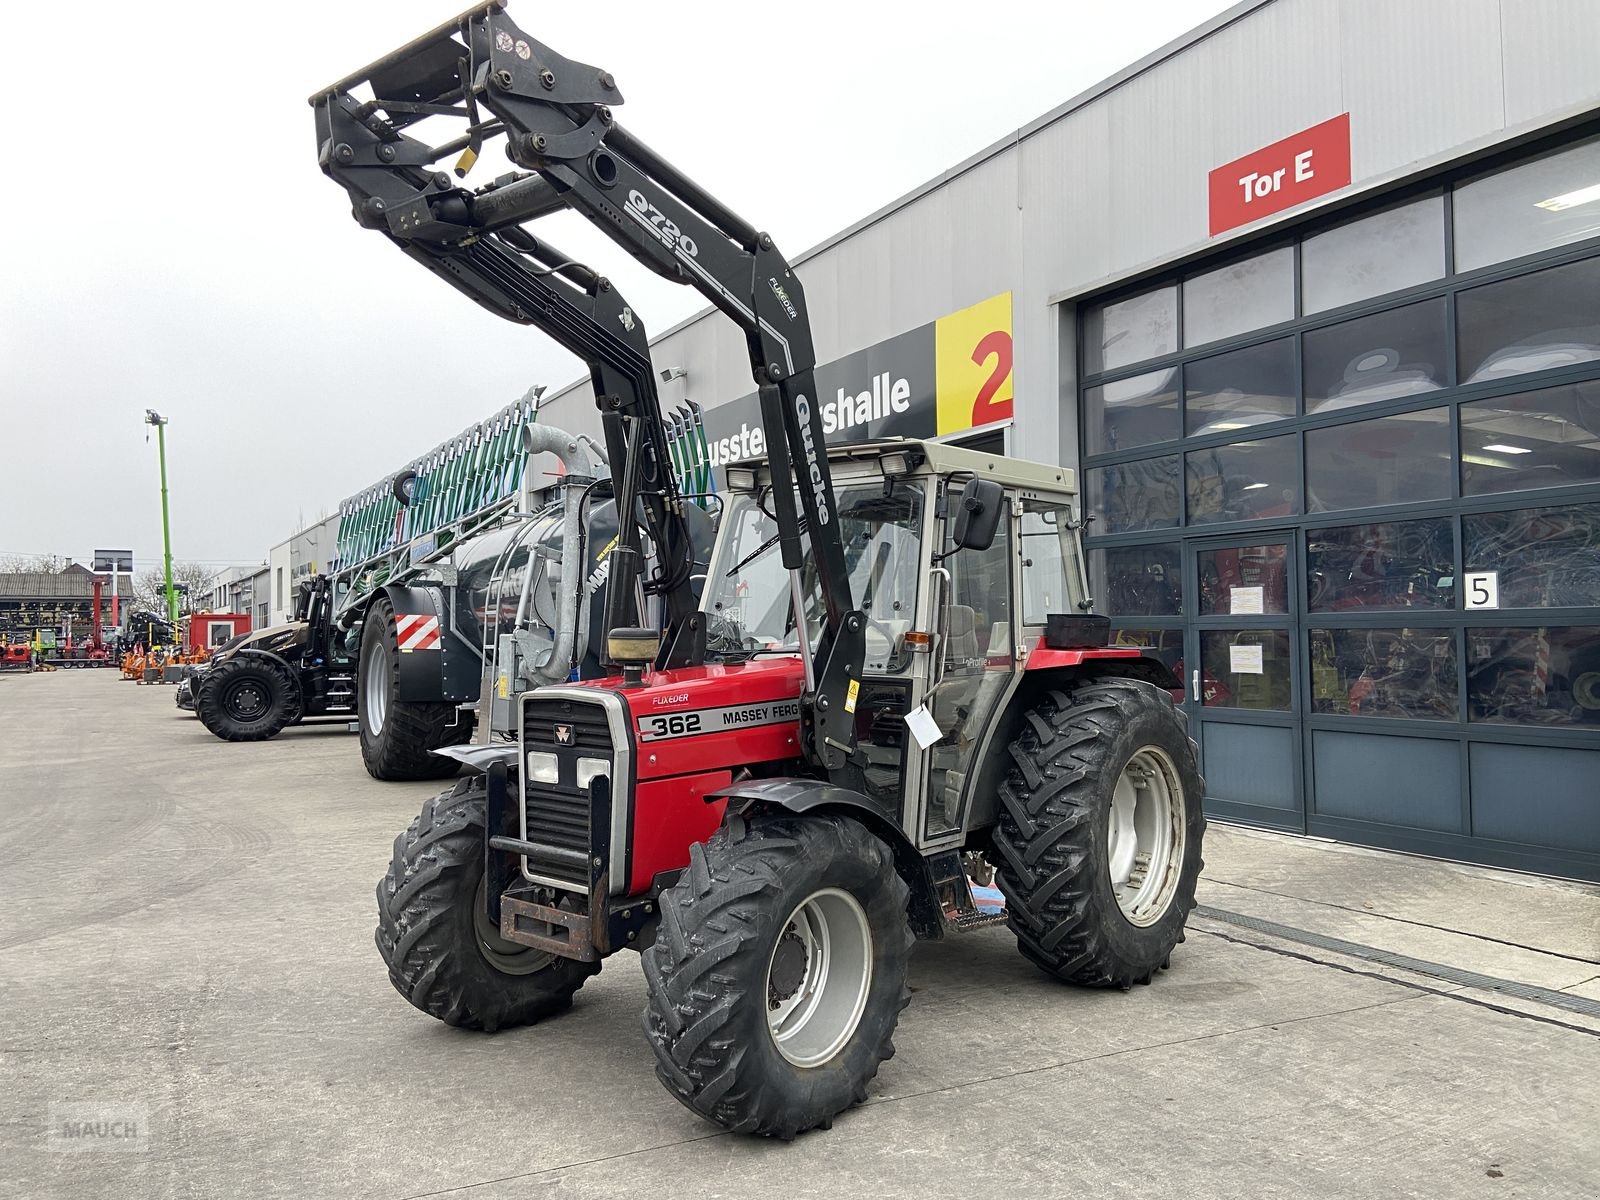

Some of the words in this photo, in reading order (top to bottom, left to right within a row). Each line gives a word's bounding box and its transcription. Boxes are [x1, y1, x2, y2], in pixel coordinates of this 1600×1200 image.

[1238, 167, 1286, 203] Tor
[1295, 149, 1314, 183] E
[628, 189, 699, 257] Q720
[971, 330, 1014, 428] 2
[796, 394, 830, 526] Quicke
[1472, 577, 1490, 606] 5
[651, 714, 702, 737] 362
[723, 707, 769, 725] MASSEY
